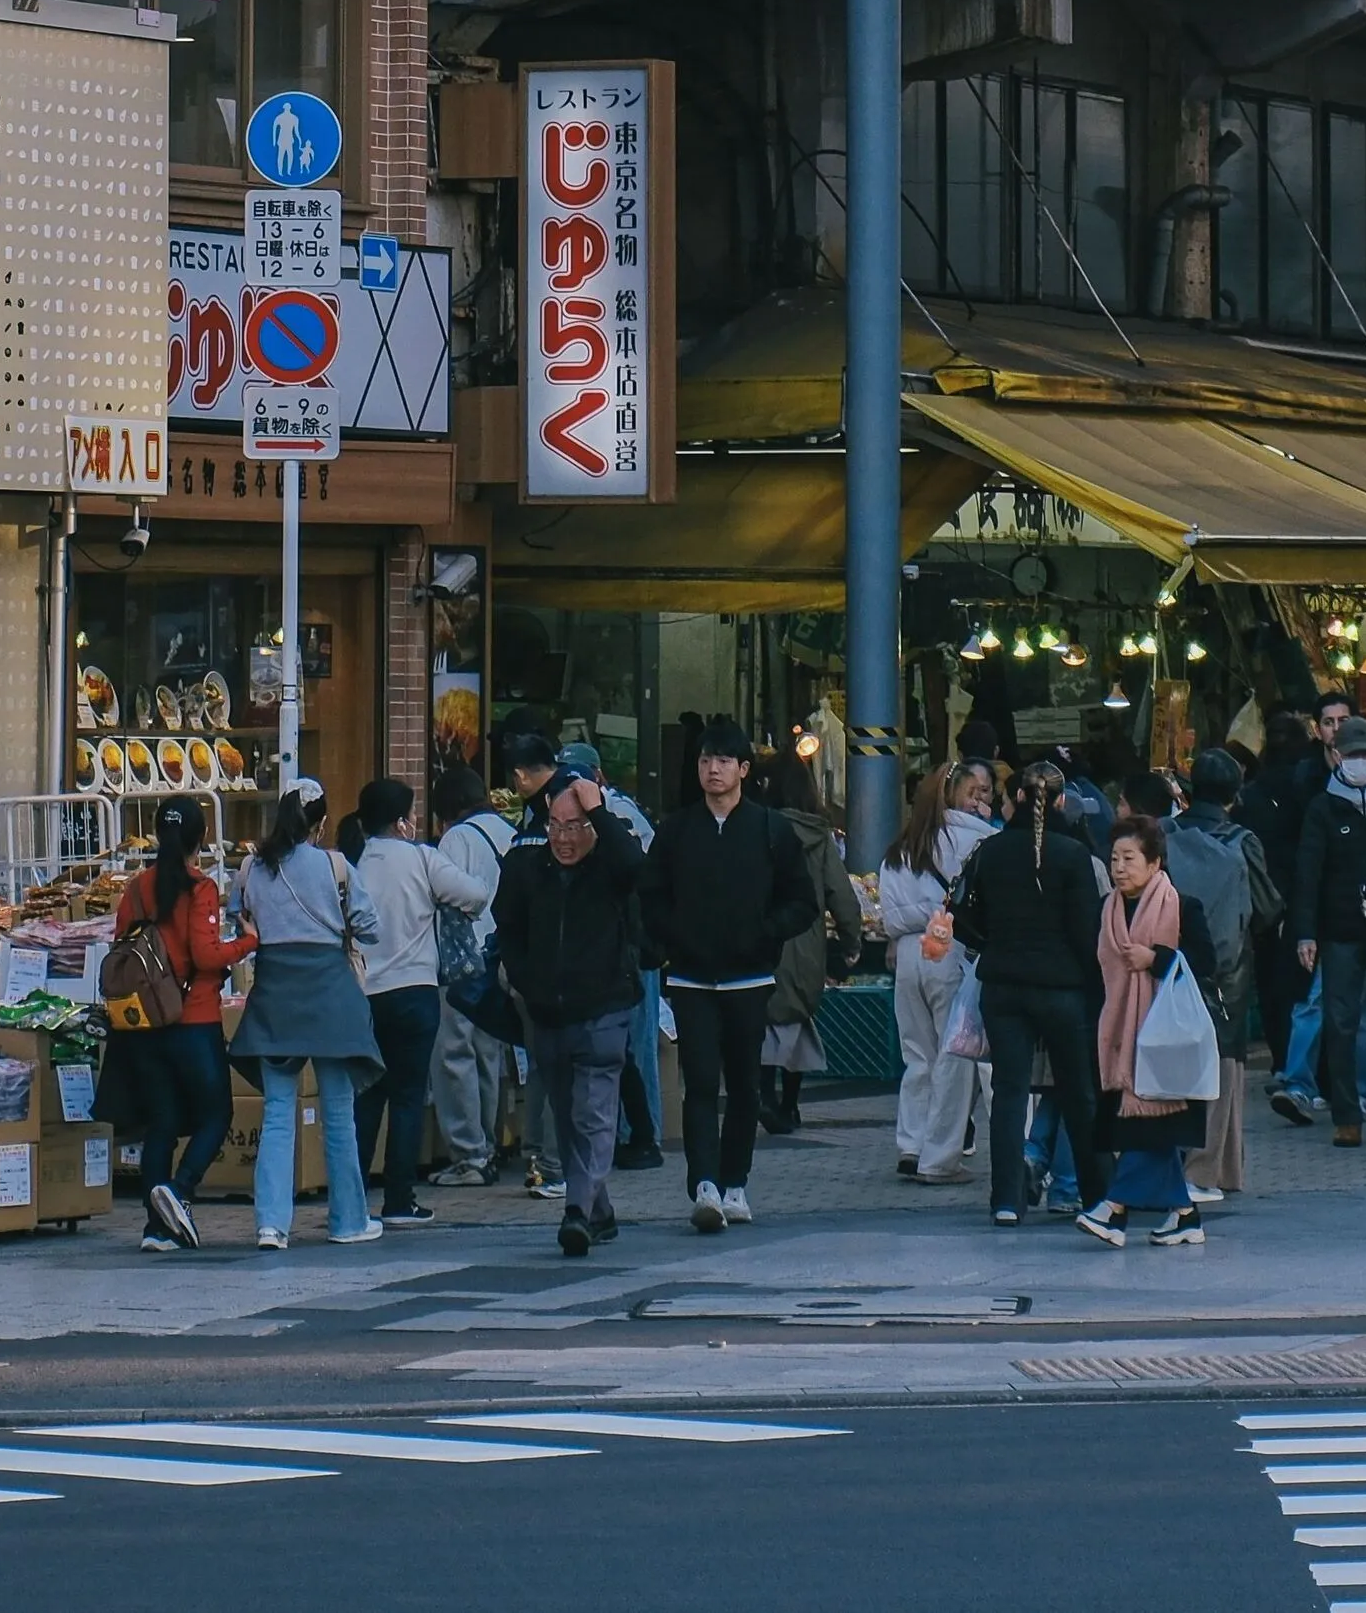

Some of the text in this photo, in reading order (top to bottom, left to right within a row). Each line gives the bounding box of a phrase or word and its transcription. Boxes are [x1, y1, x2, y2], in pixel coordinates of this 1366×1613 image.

[535, 87, 642, 112] レストラン
[251, 198, 333, 220] 自転車を除く
[255, 239, 330, 260] 日曜・休日は
[537, 119, 611, 480] じゅらく
[614, 122, 639, 473] 東京名物 総本店直営
[250, 416, 333, 437] 貨物を除く
[69, 426, 112, 486] アメ横
